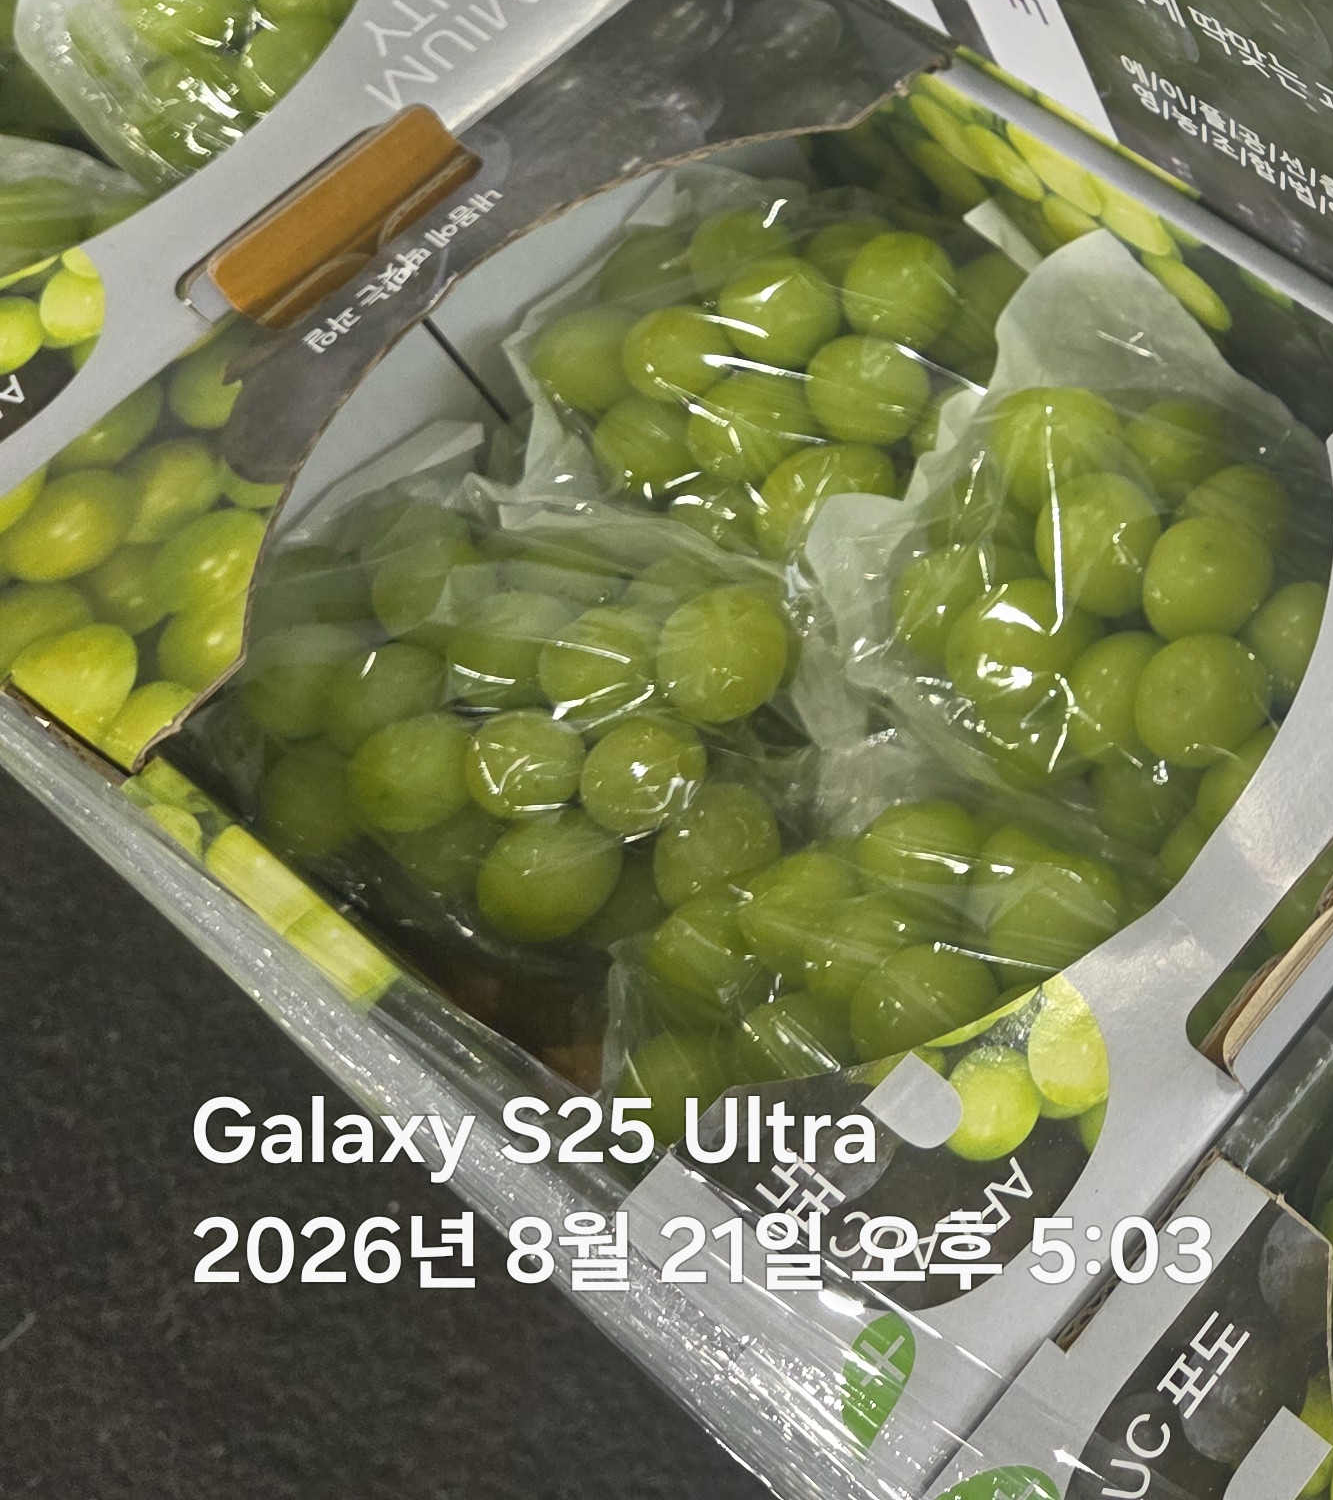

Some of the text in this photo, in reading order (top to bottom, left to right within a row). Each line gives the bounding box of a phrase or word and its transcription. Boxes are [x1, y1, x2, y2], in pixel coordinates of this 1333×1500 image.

[1187, 5, 1308, 101] 딱맞는
[302, 189, 504, 354] 내몸에 딱맞는 과일
[1156, 1310, 1251, 1420] 포도
